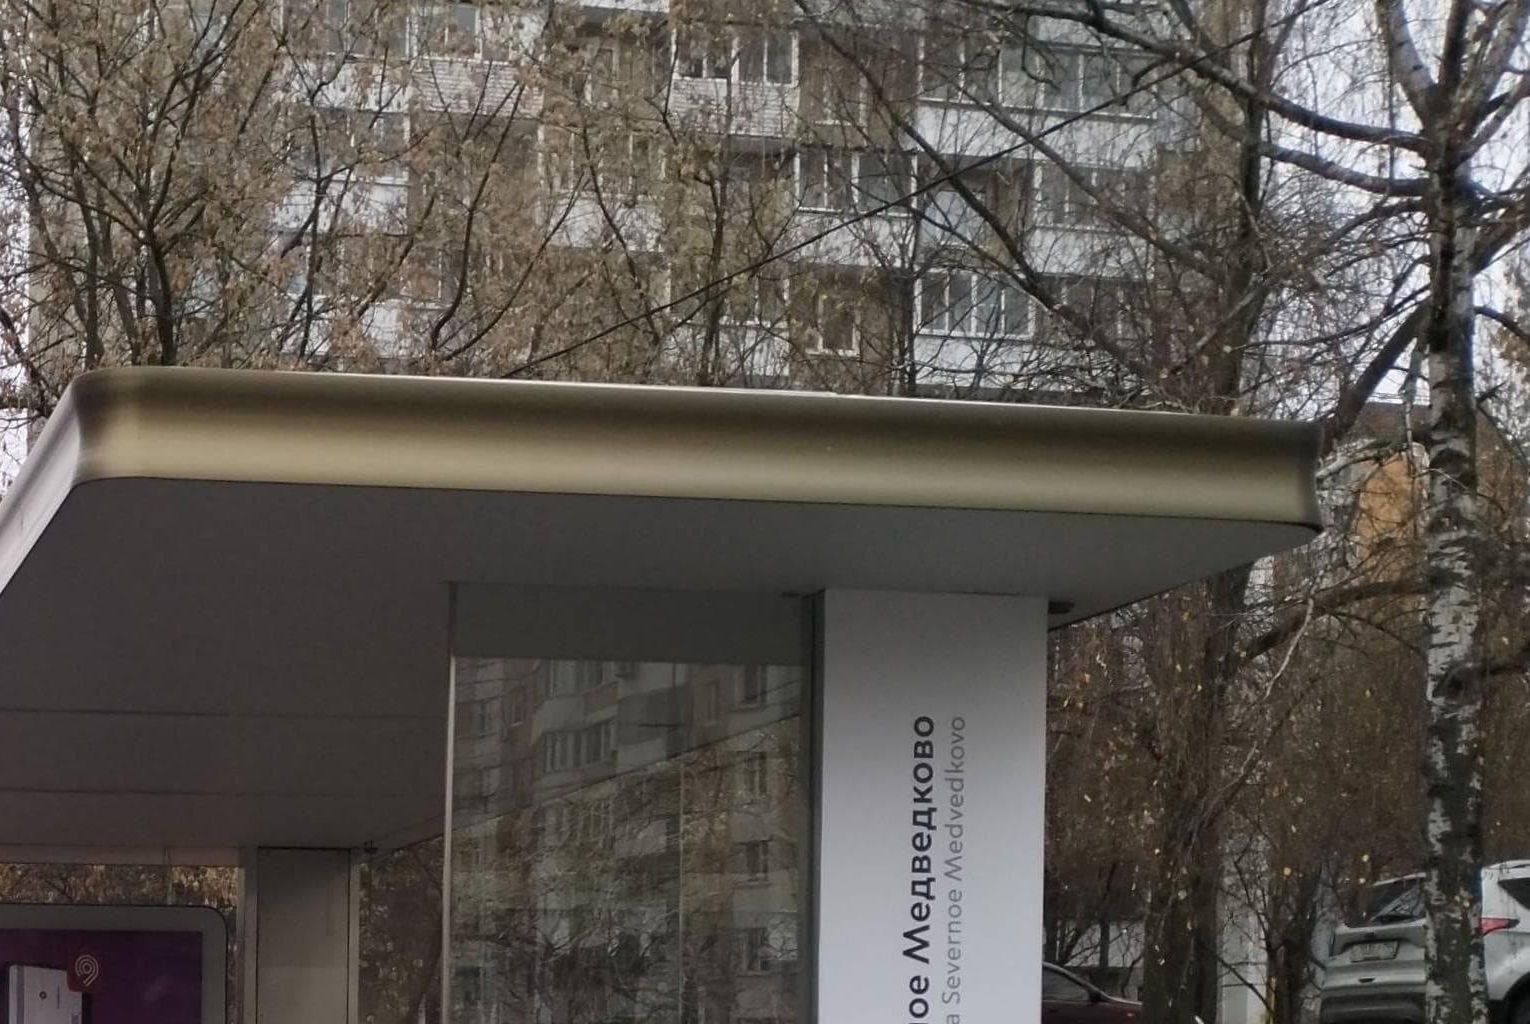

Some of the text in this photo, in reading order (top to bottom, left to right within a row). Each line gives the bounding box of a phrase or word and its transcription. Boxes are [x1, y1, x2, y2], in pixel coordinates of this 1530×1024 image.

[902, 716, 937, 964] Медведково
[944, 716, 965, 882] Medvedkovo
[942, 888, 962, 1004] Severnoe
